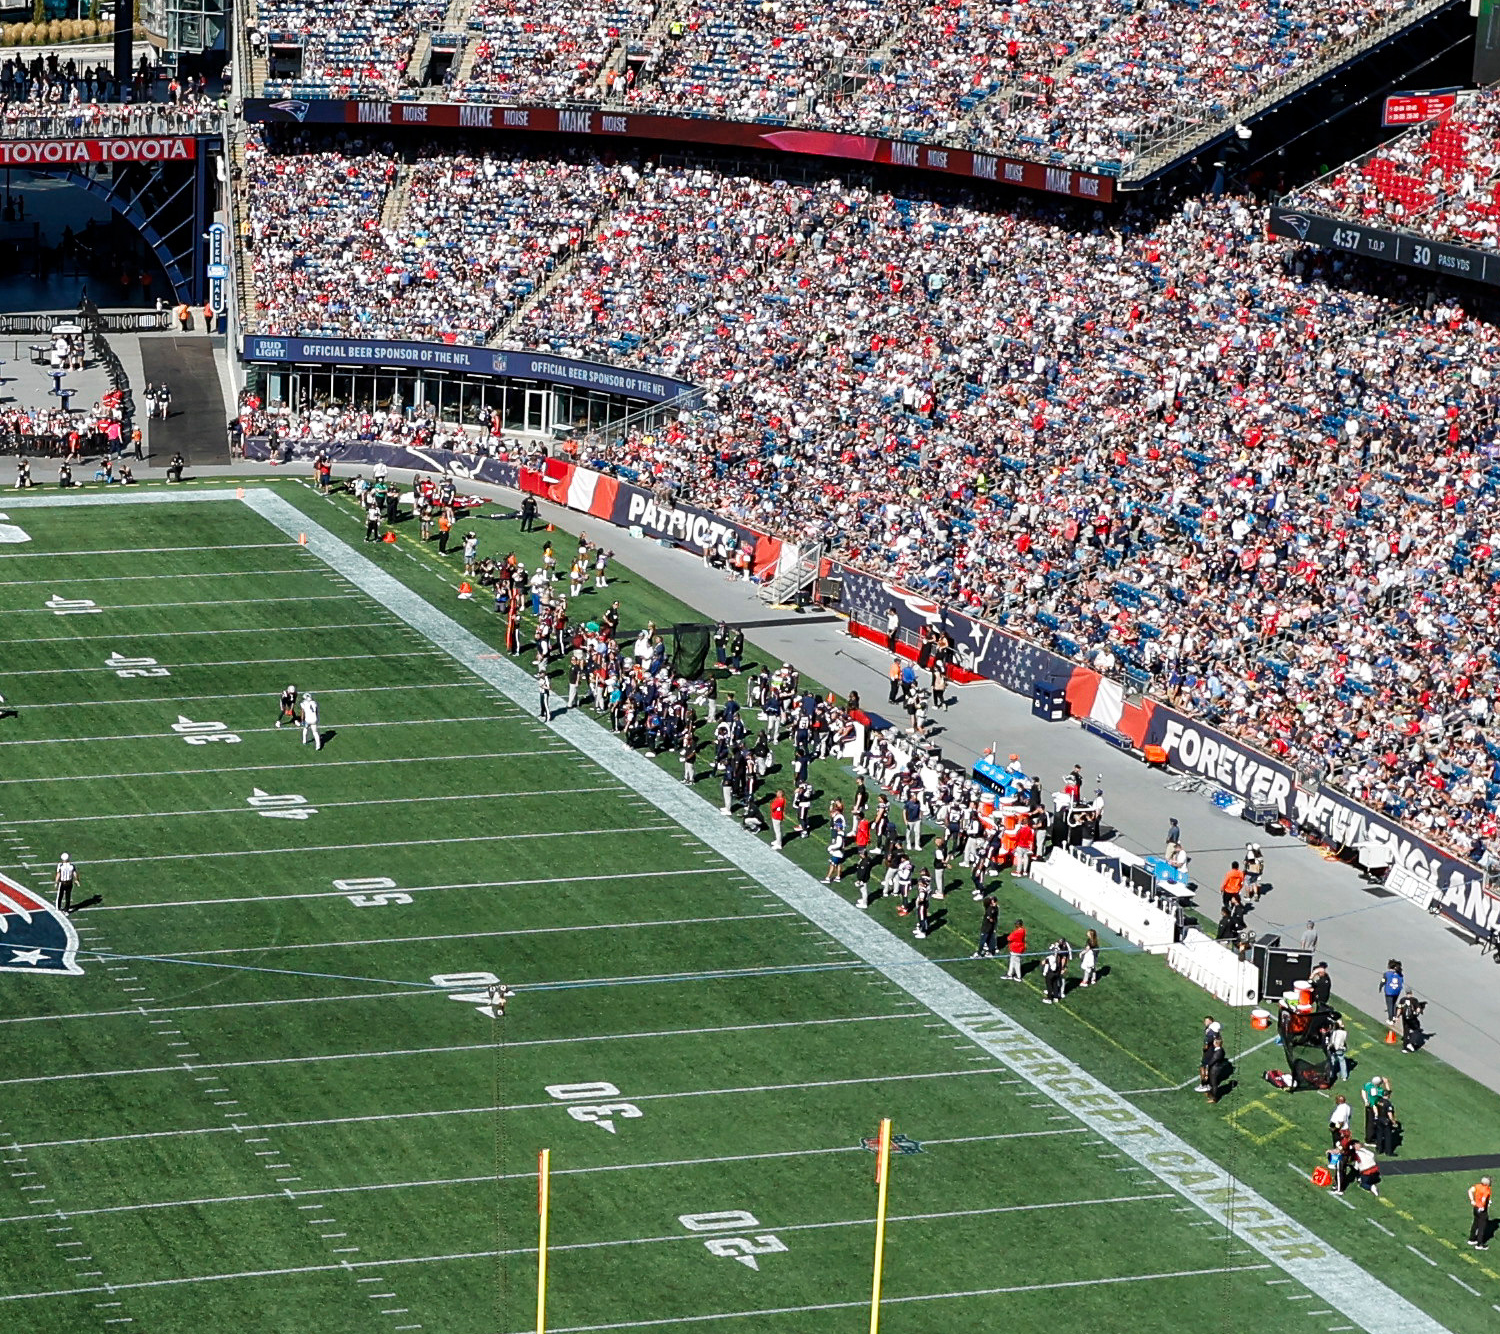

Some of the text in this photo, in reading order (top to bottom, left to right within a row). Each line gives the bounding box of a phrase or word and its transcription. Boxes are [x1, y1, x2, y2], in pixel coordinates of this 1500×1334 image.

[358, 102, 428, 124] MAKE NOISE
[0, 142, 87, 164] TOYOTA
[98, 138, 190, 160] TOYOTA
[255, 349, 286, 358] LIGHT
[259, 340, 281, 349] BUD
[303, 344, 471, 365] OFFICIAL BEER SPONSOR OF THE NFL
[531, 361, 567, 377] OFFICIAL
[568, 367, 587, 380] BEER
[589, 370, 624, 387] SPONSOR
[626, 378, 636, 390] OF
[637, 380, 651, 393] THE
[652, 383, 665, 397] NFL
[1161, 719, 1291, 815] FOREVER
[246, 794, 319, 820] 40
[332, 876, 414, 908] 50
[544, 1081, 643, 1122] 30
[678, 1209, 789, 1259] 20
